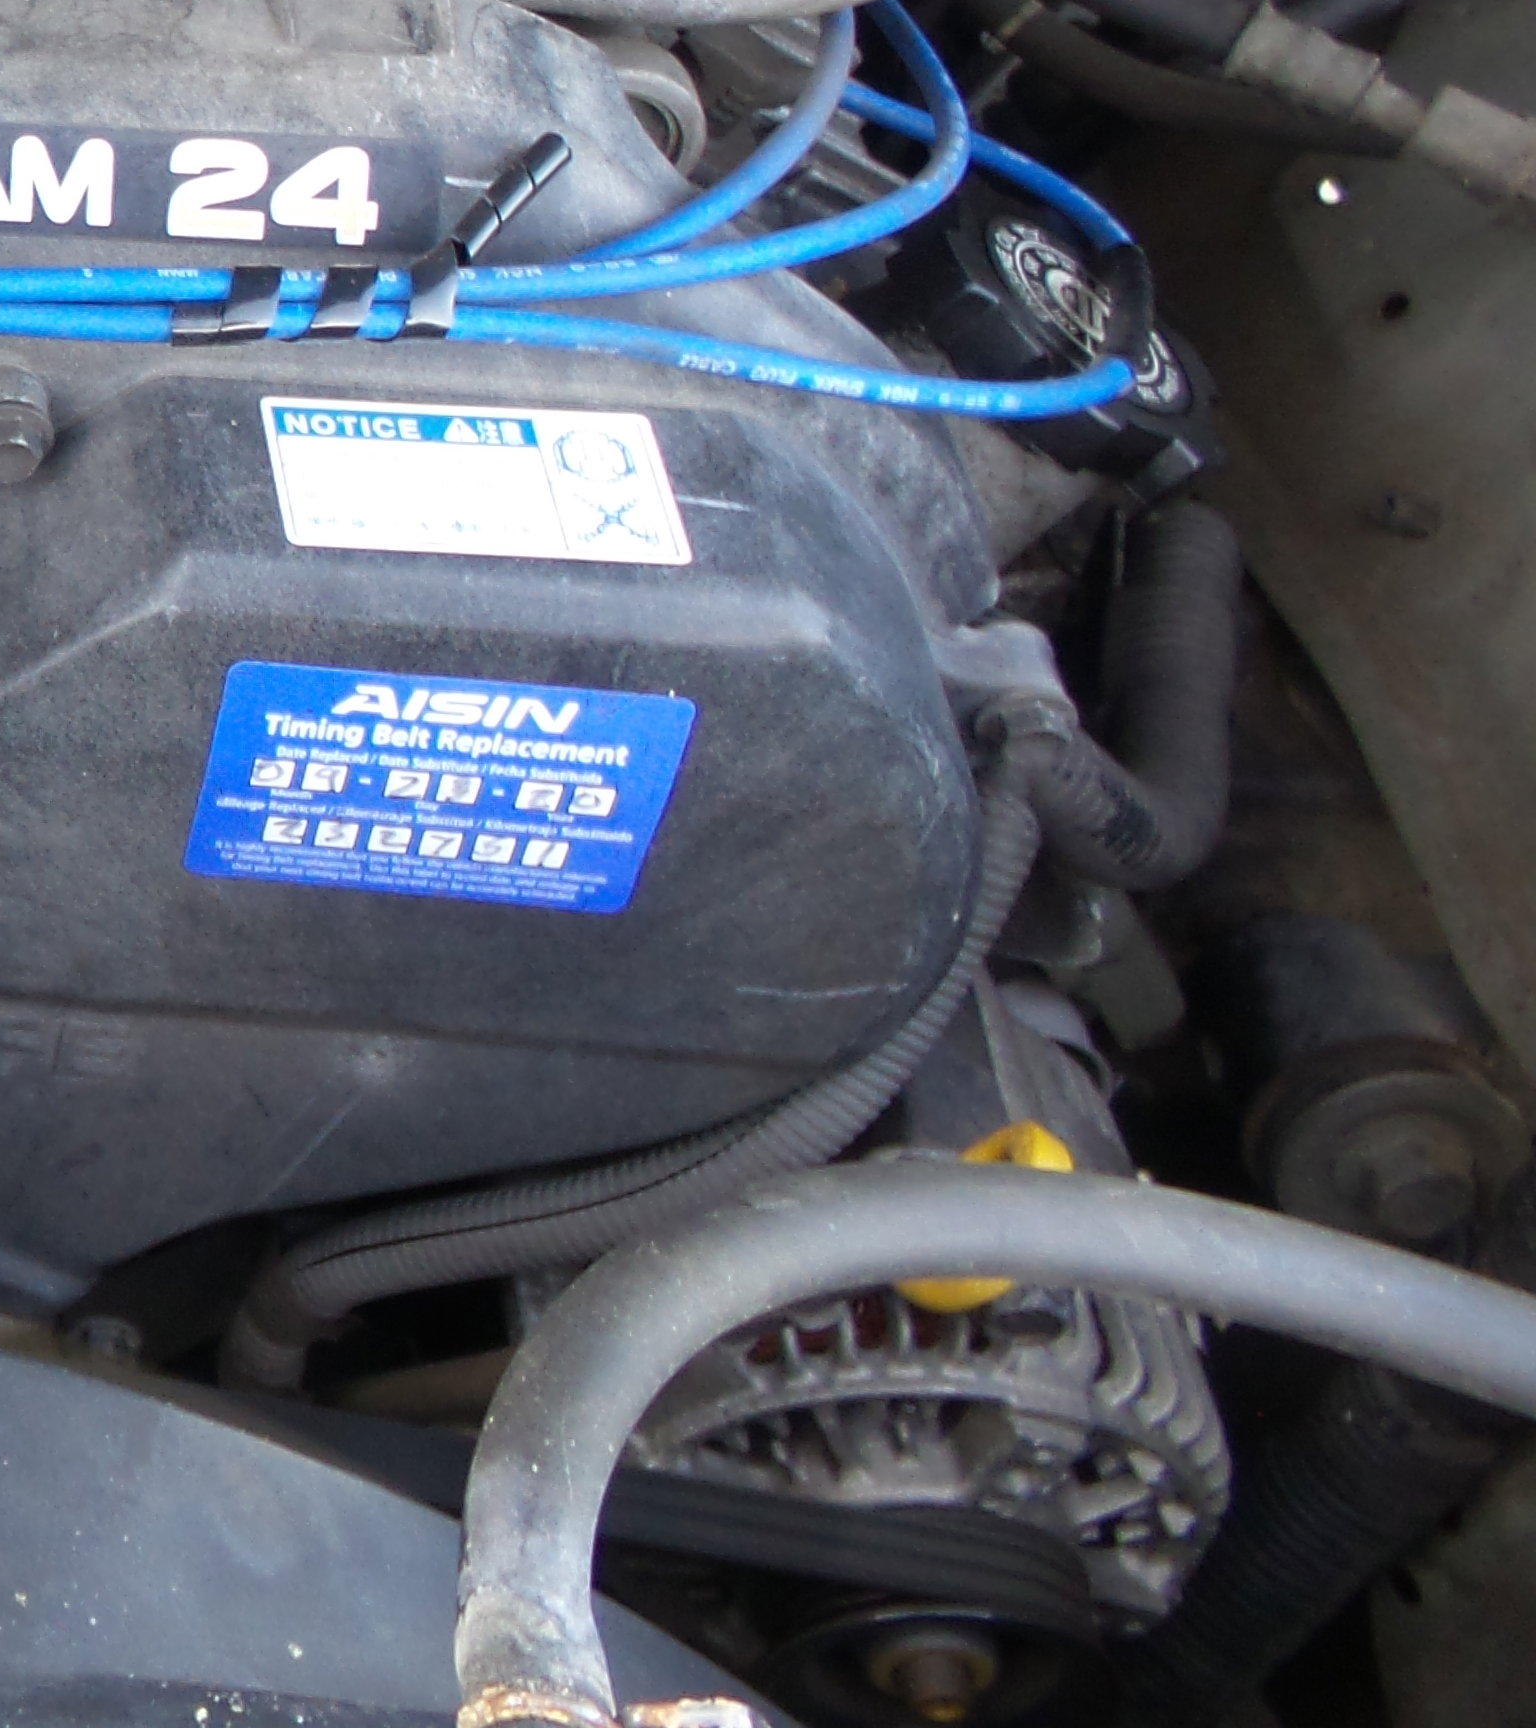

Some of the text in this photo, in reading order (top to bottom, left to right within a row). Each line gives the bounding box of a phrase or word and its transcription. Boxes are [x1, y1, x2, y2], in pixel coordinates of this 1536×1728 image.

[166, 138, 380, 248] 24
[282, 411, 422, 441] NOTICE
[330, 683, 580, 735] AISIN
[264, 712, 630, 768] Timing Belt Replacement
[275, 744, 308, 760] Date
[309, 747, 370, 765] Replaced
[378, 753, 410, 768] Date
